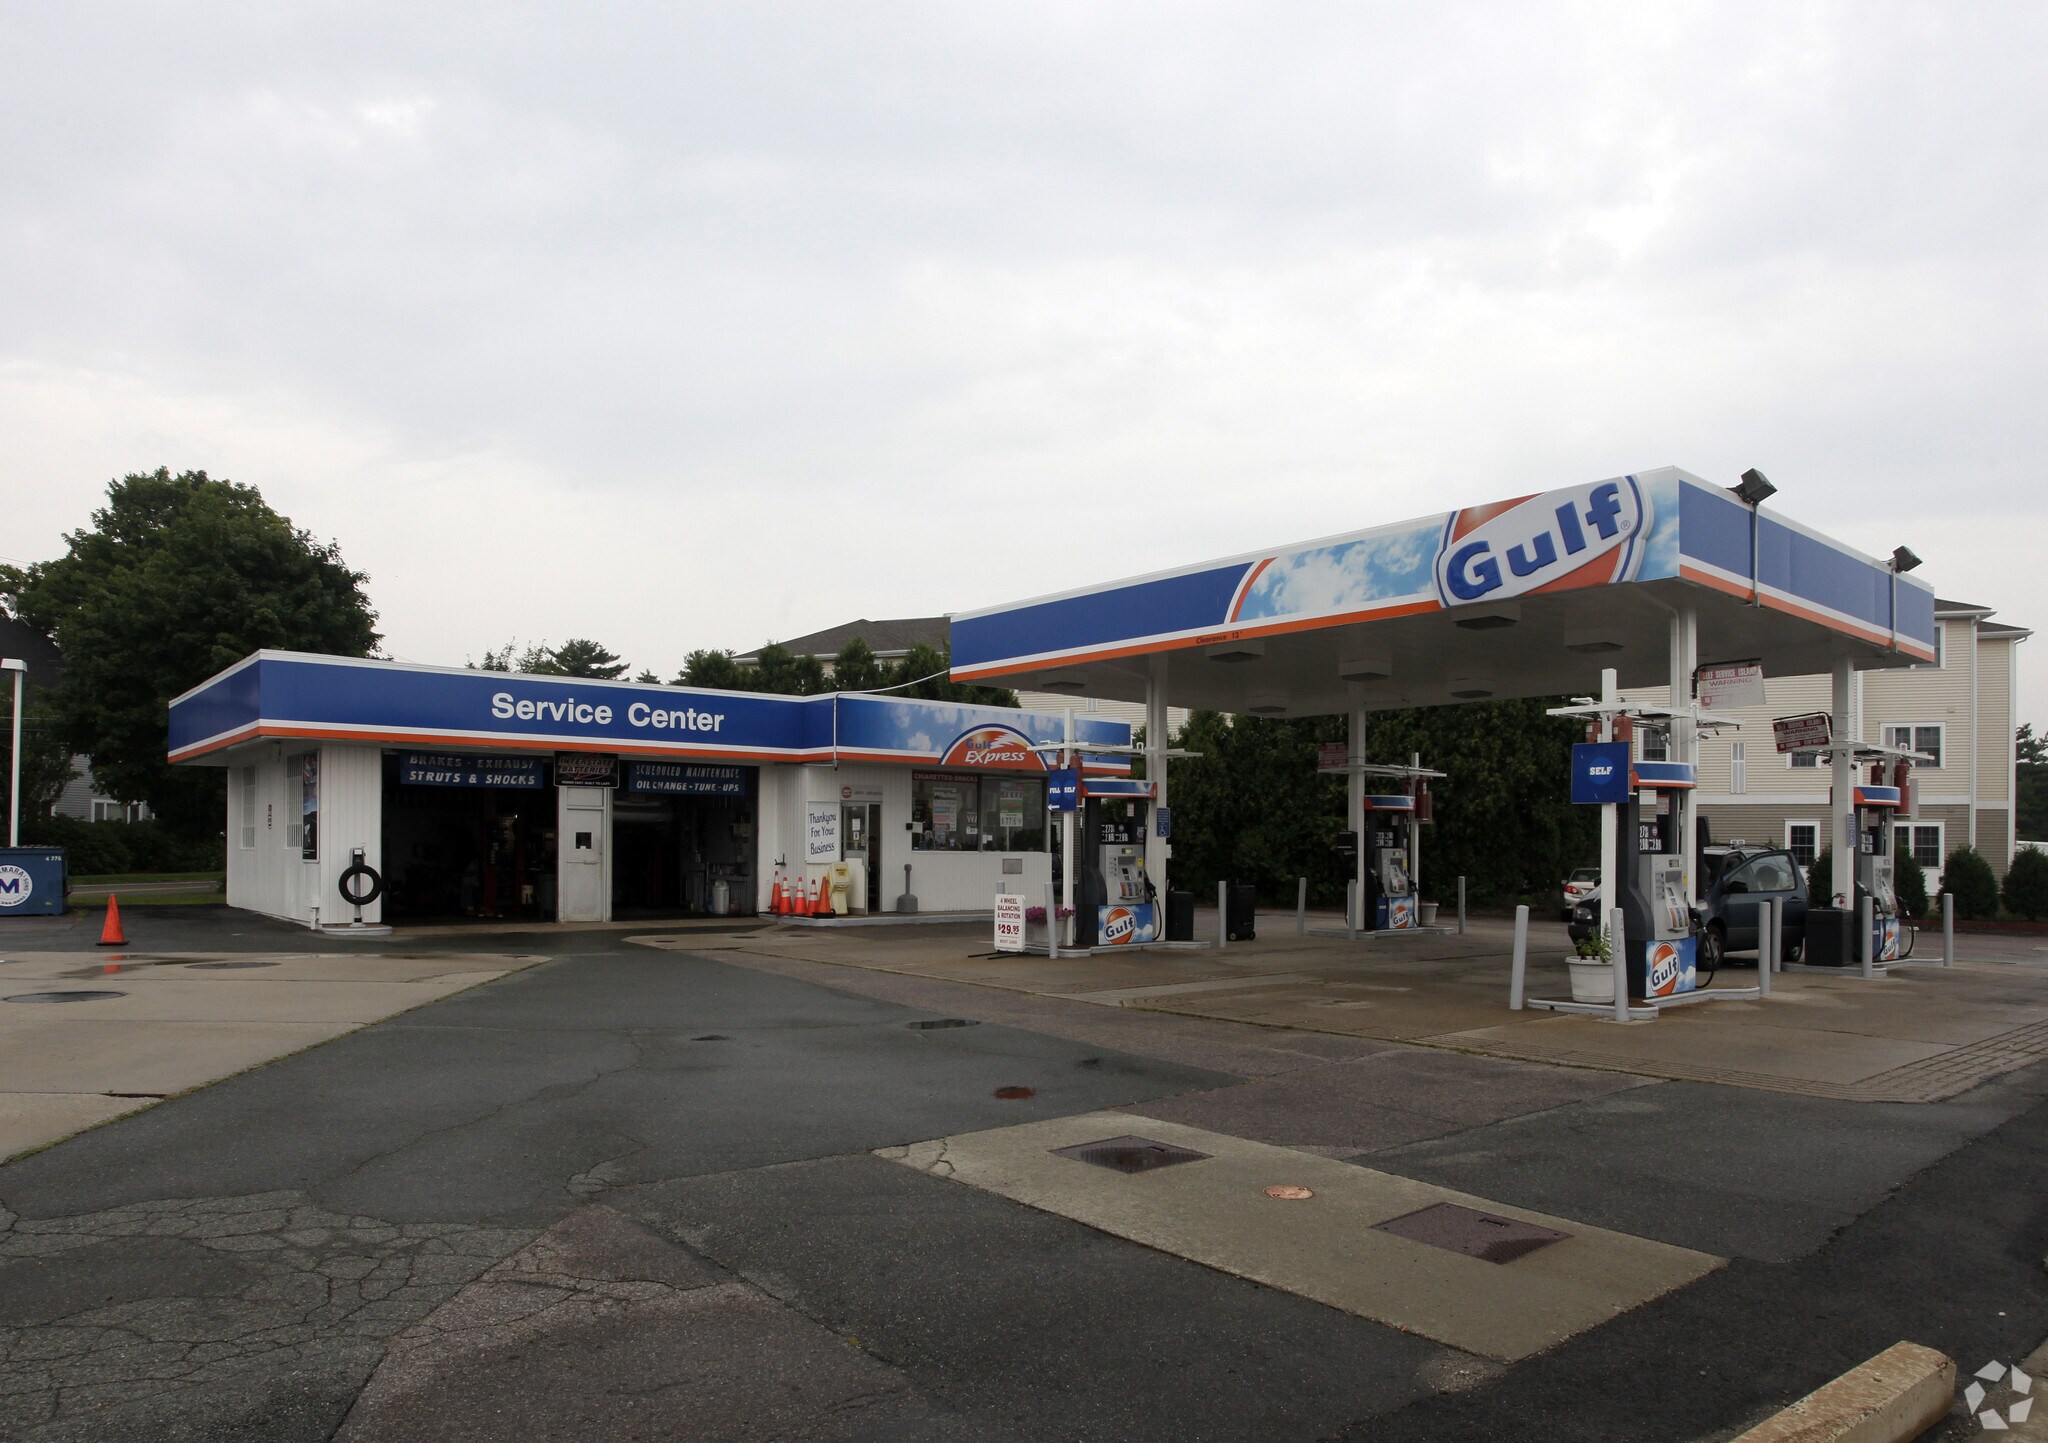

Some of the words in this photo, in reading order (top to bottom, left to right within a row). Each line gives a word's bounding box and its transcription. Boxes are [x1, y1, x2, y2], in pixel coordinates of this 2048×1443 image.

[1447, 482, 1621, 600] Gulf
[1196, 634, 1227, 644] Clearance
[1709, 677, 1752, 687] WARNING
[492, 692, 613, 725] Service
[628, 702, 724, 732] Center
[1783, 726, 1818, 736] WARNING
[966, 738, 993, 750] Gulf
[409, 755, 462, 767] BRAKES
[560, 757, 612, 766] INTERSTATE
[561, 765, 610, 774] BATTERIES
[636, 764, 681, 777] SCHEDULED
[686, 767, 740, 778] MAINTENANCE
[1589, 766, 1613, 776] SELF
[409, 771, 461, 783] STRUTS
[468, 774, 477, 784] &
[485, 774, 535, 785] SHOCKS
[636, 780, 650, 789] OIL
[652, 781, 687, 791] CHANGE
[811, 827, 820, 838] For
[821, 826, 835, 837] Your
[810, 841, 835, 855] Business
[1003, 897, 1018, 905] WHEEL
[1393, 912, 1409, 925] Gulf
[998, 923, 1020, 935] $29.95
[1105, 917, 1134, 938] Gulf
[1652, 957, 1677, 987] Gulf
